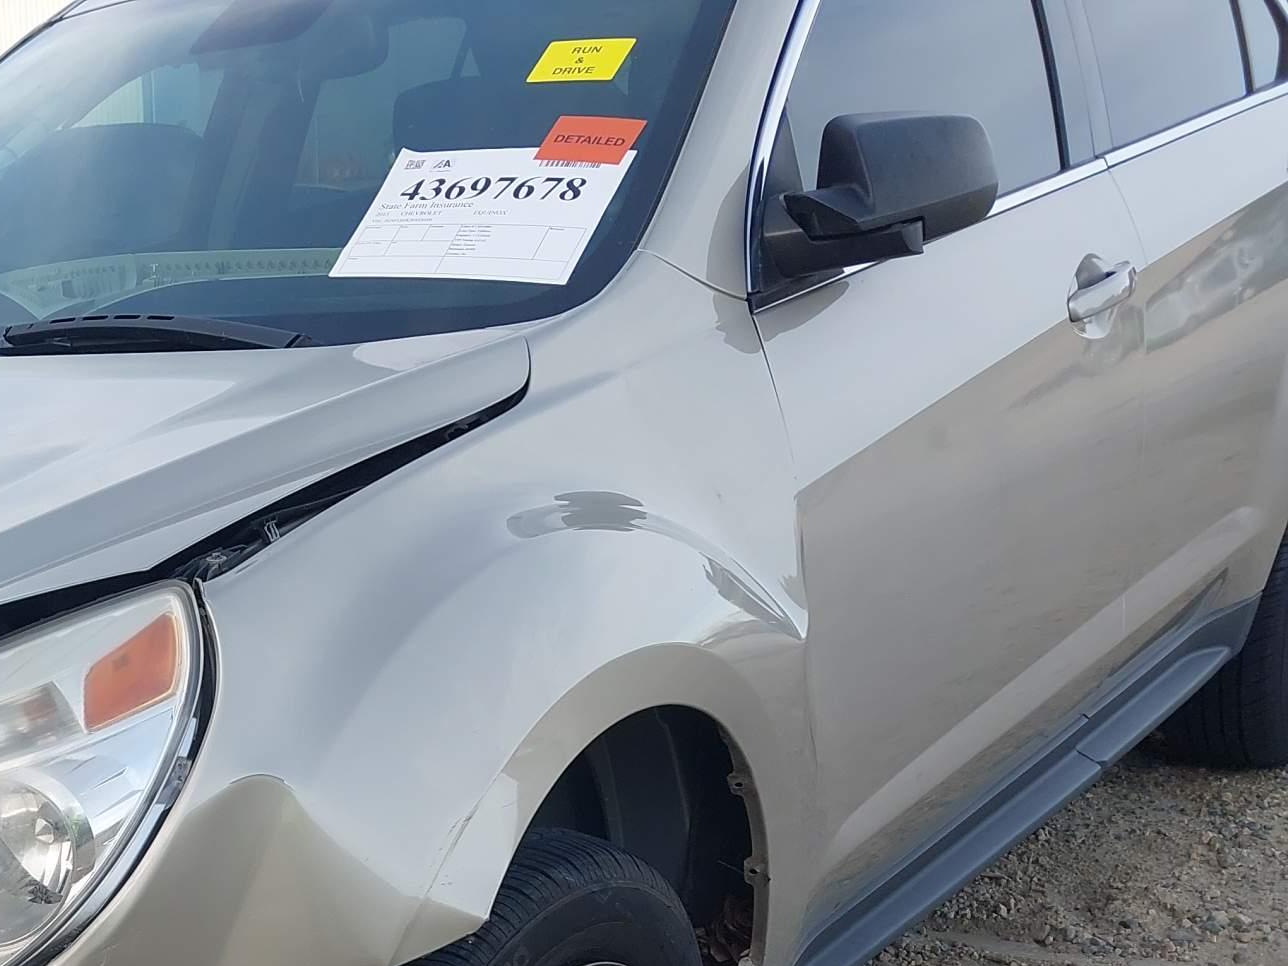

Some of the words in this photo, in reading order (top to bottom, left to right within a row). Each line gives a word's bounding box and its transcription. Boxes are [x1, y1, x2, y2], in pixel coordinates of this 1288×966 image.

[572, 46, 602, 54] RUN
[552, 67, 595, 75] DRIVE
[554, 134, 625, 147] DETAILED
[400, 176, 587, 201] 43697678
[379, 202, 402, 210] State
[429, 201, 475, 209] Insurance
